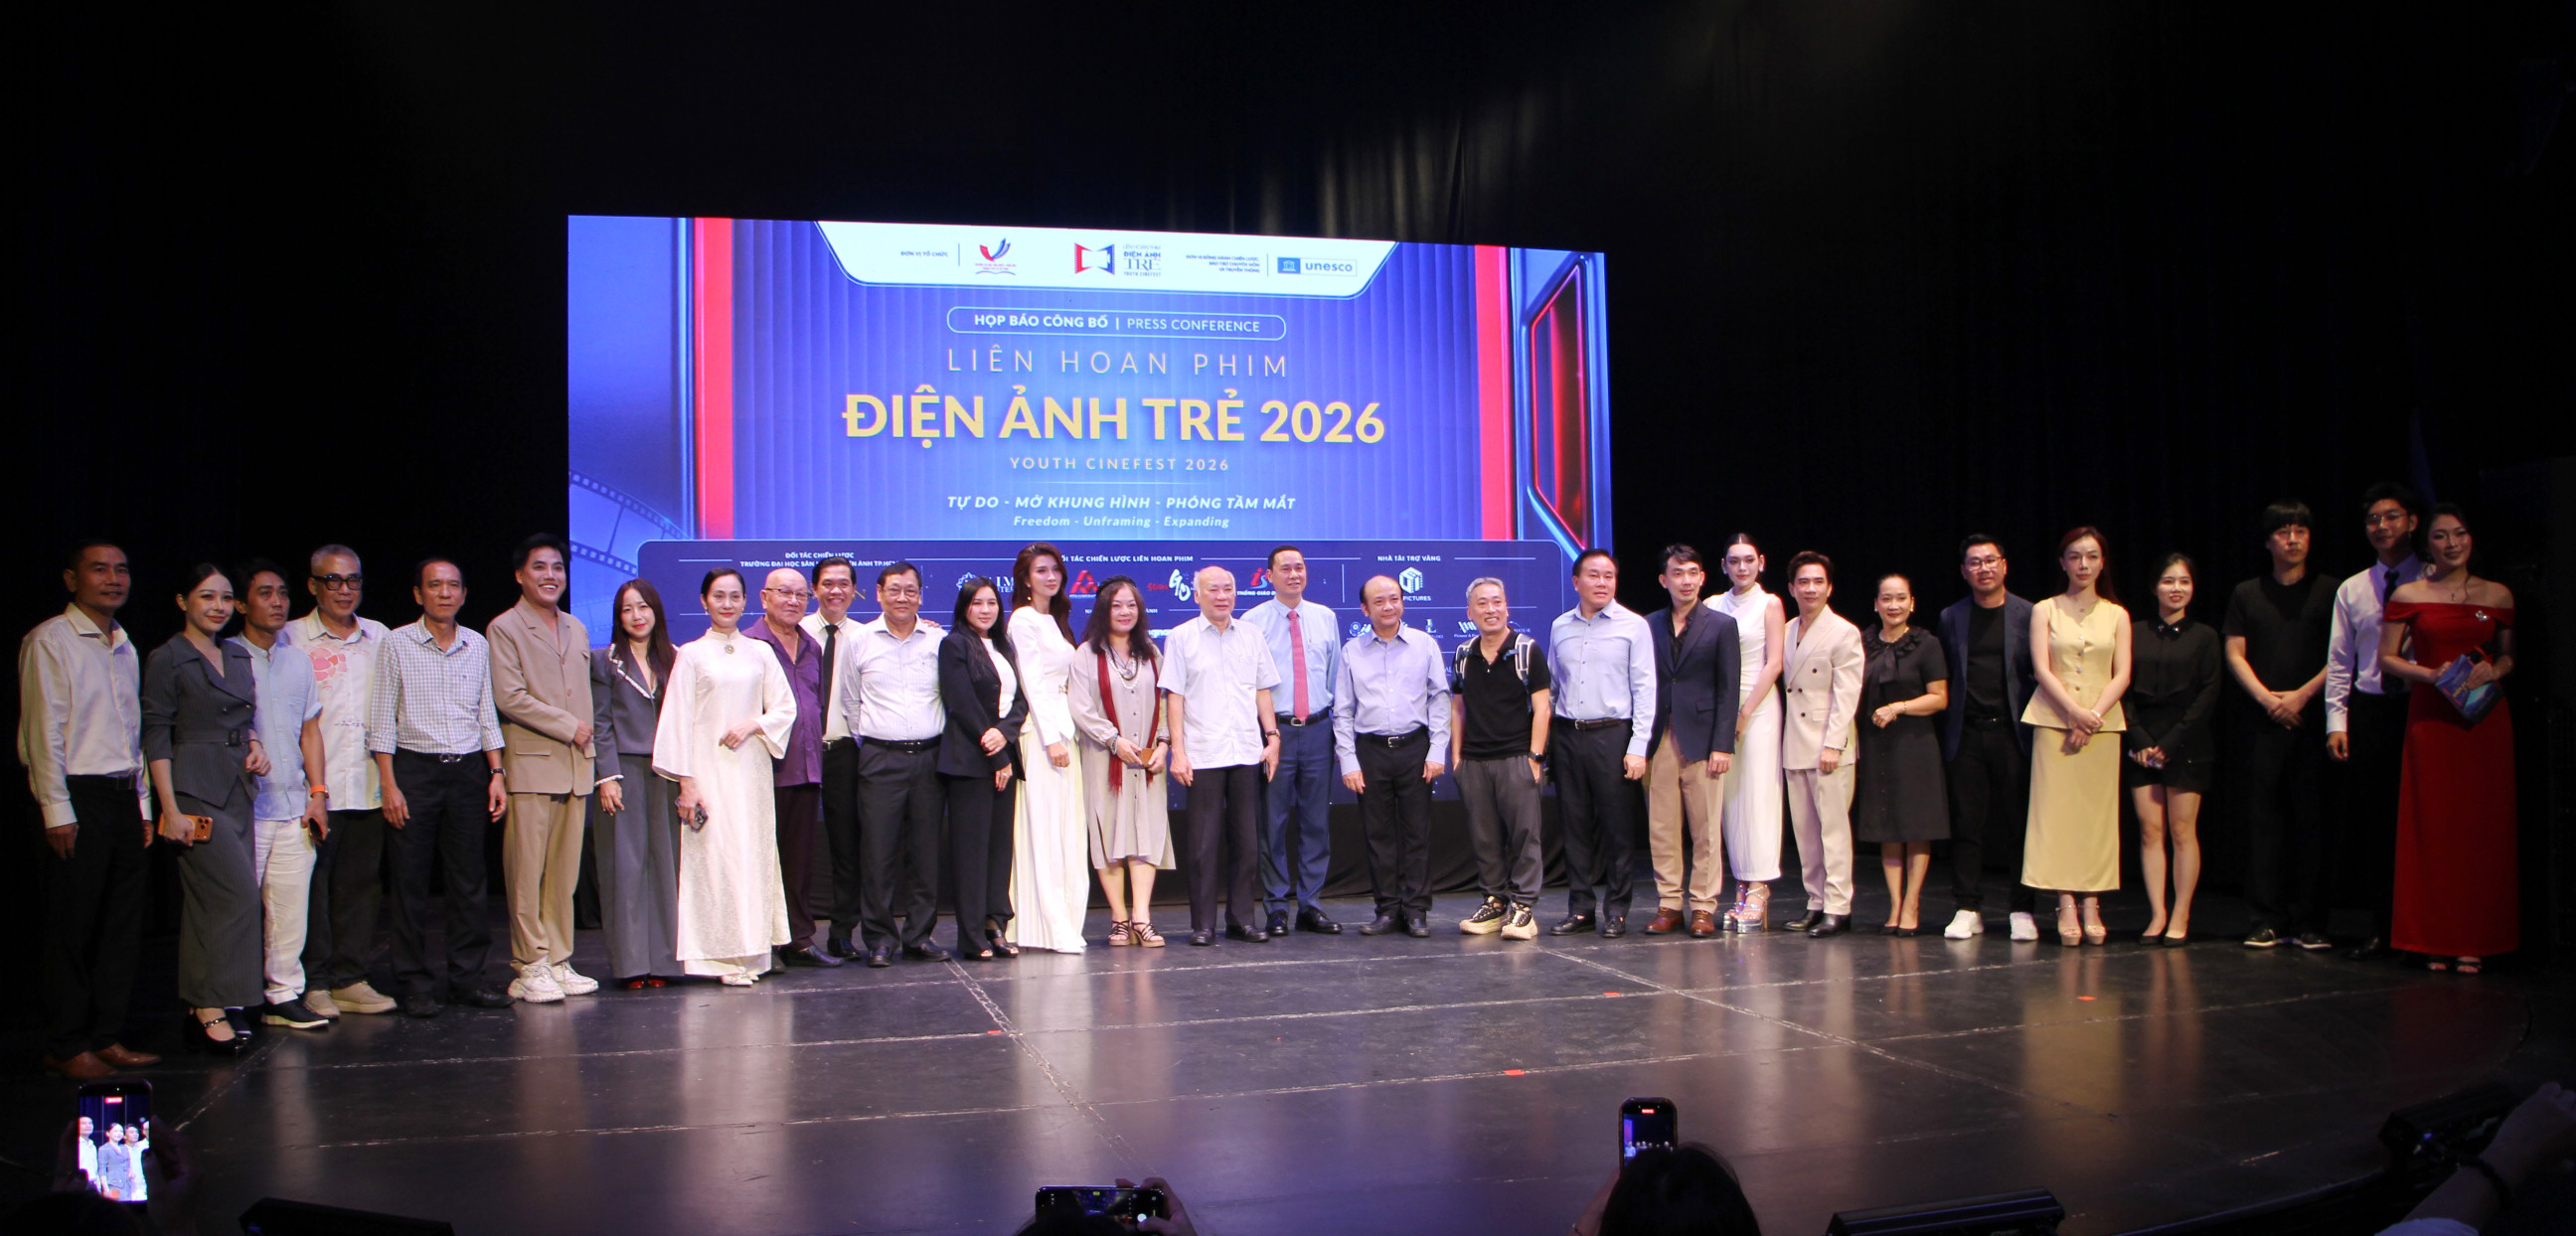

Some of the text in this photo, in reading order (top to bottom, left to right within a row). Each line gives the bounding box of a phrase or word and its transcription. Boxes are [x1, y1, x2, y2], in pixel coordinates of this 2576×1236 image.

[1306, 261, 1353, 272] unesco
[974, 314, 1006, 328] HỌP
[1010, 313, 1040, 327] BÁO
[1044, 314, 1084, 328] CÔNG
[1088, 314, 1109, 329] BỐ
[1127, 318, 1167, 331] PRESS
[1172, 319, 1260, 333] CONFERENCE
[948, 344, 1286, 378] LIÊN HOAN PHIM
[842, 384, 1385, 449] ĐIỆN ẢNH TRẺ 2026
[1010, 457, 1229, 472] YOUTH CINEFEST 2026
[948, 495, 971, 511] TỰ
[975, 497, 999, 509] DO
[1015, 495, 1044, 509] MỞ
[1047, 497, 1105, 509] KHUNG
[1109, 495, 1151, 509] HÌNH
[1166, 495, 1222, 510] PHÓNG
[1226, 494, 1259, 510] TẦM
[1263, 495, 1296, 510] MẮT
[1014, 516, 1070, 527] Freedom
[1083, 516, 1151, 529] Unframing
[1164, 516, 1230, 529] Expanding
